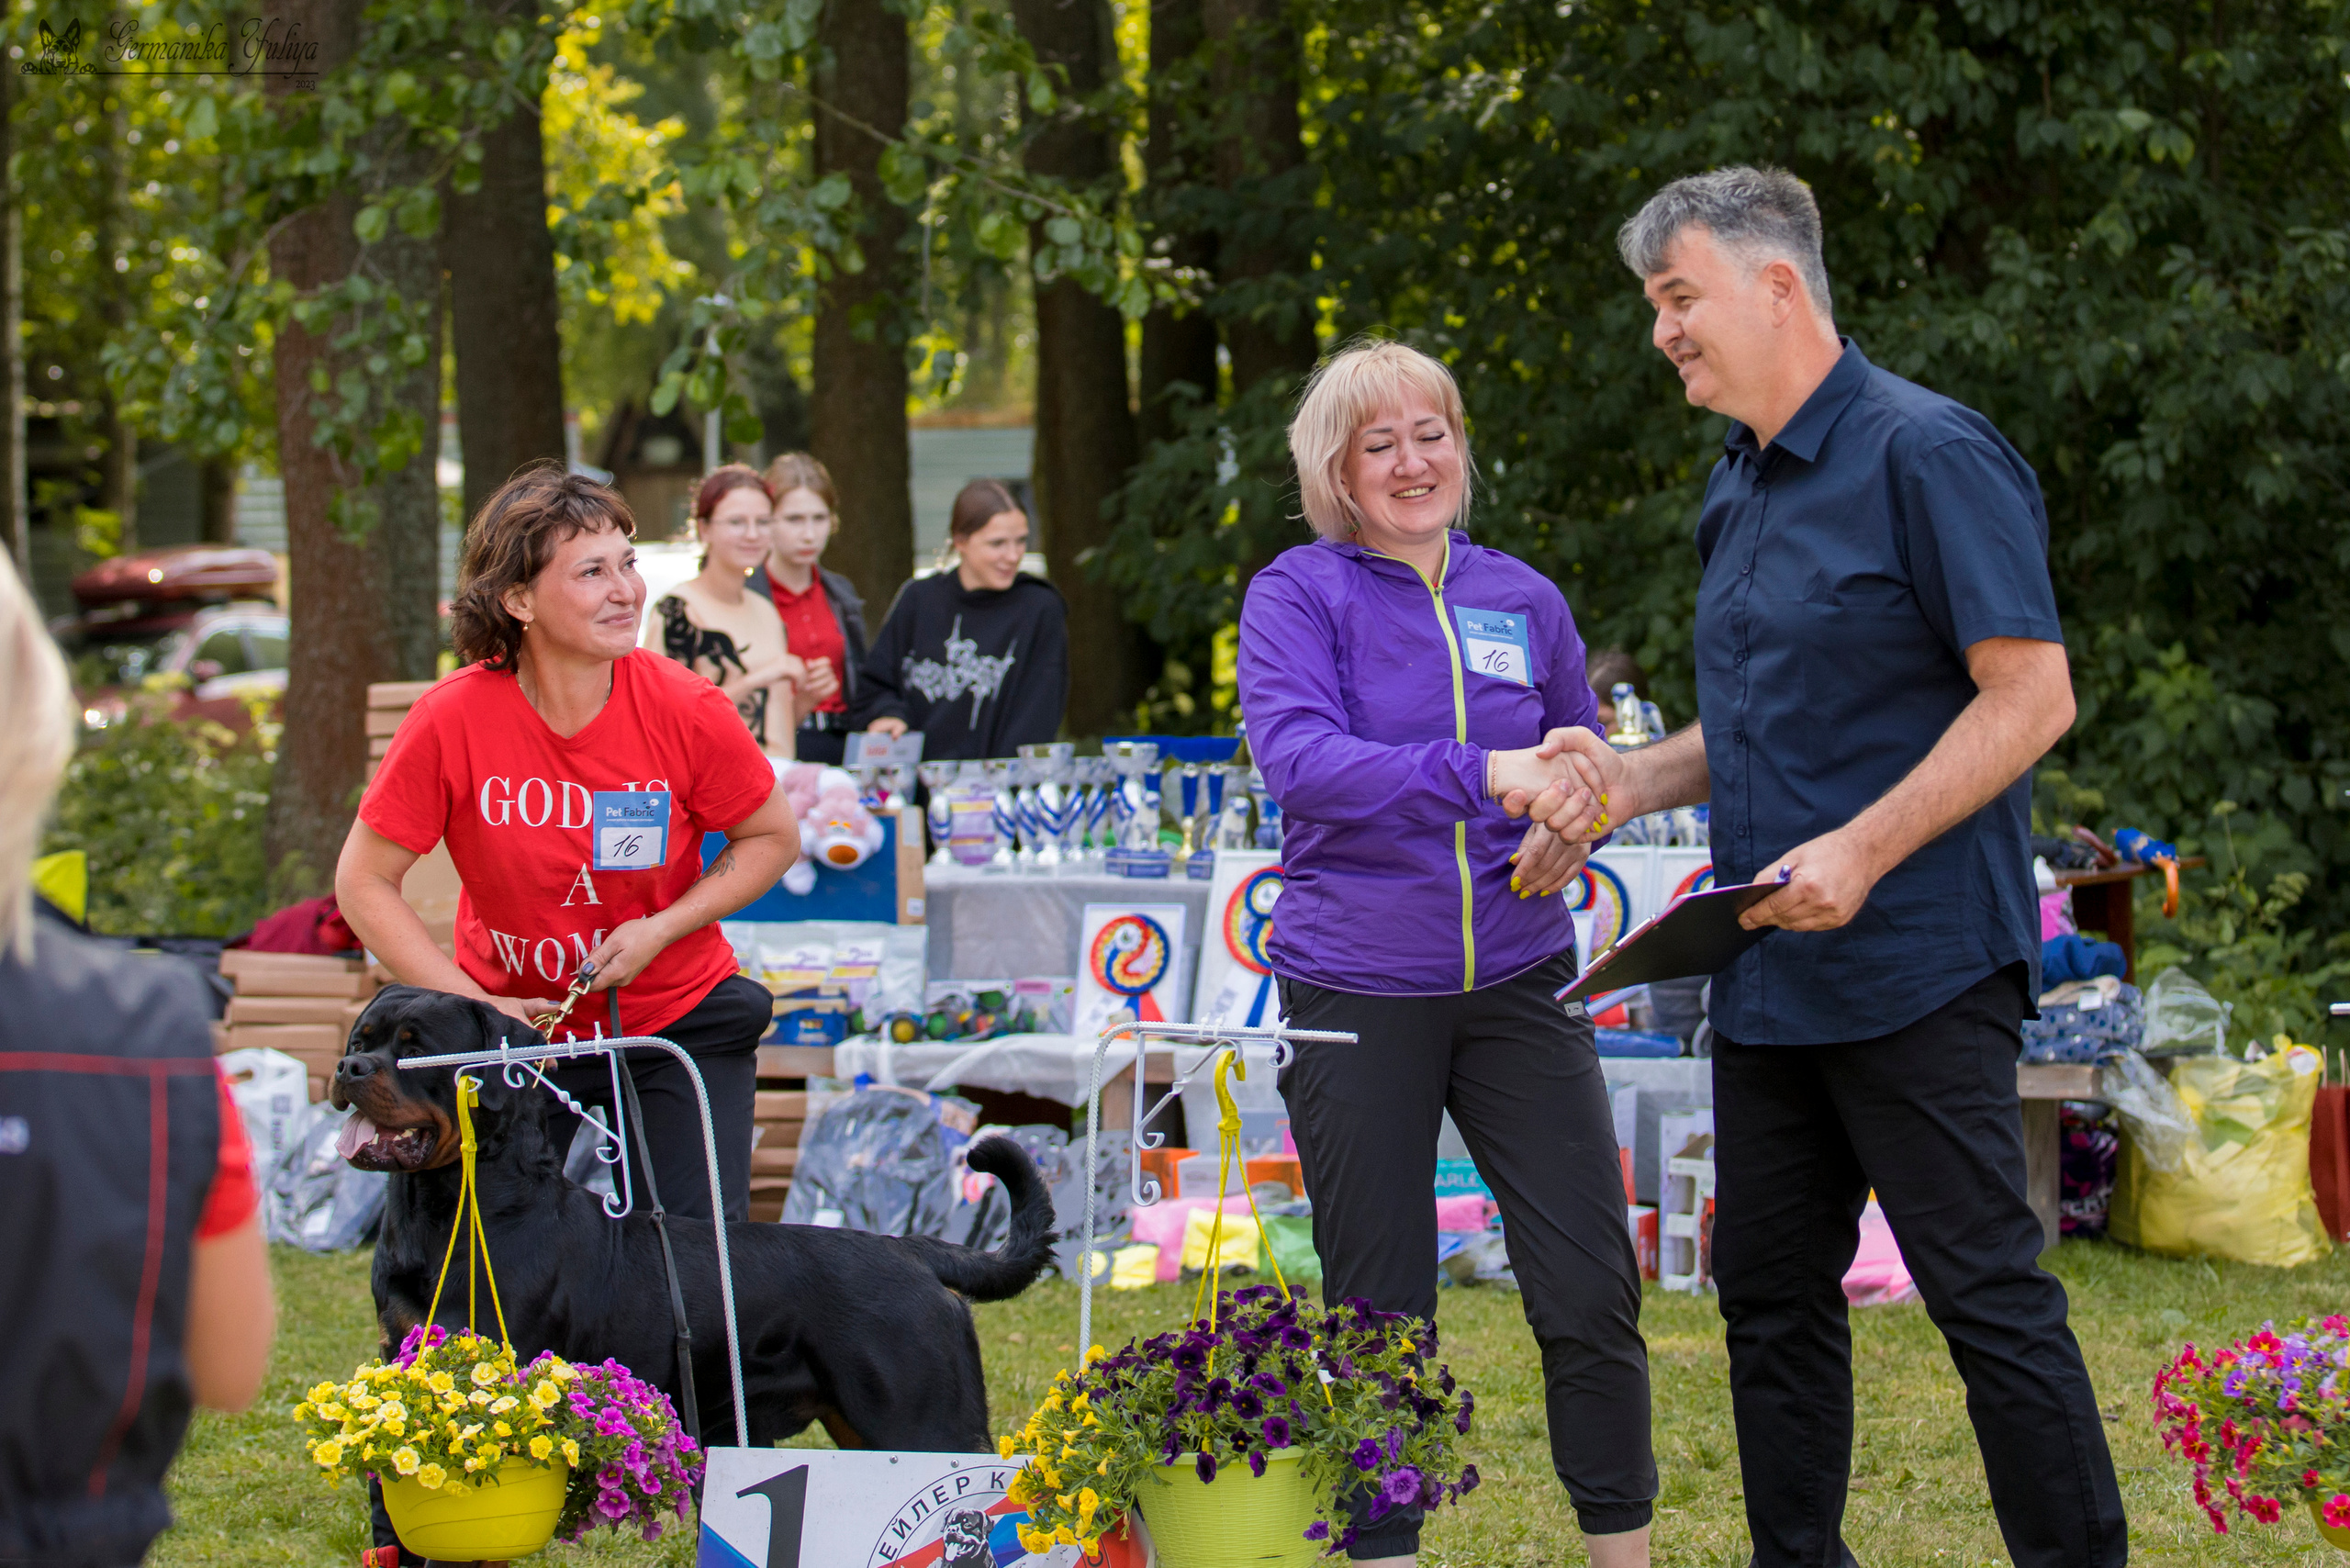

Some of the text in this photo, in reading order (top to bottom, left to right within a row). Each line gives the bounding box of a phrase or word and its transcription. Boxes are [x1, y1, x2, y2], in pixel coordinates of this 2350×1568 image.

[1467, 620, 1483, 632] Pet
[1483, 622, 1513, 635] Fabric
[1483, 649, 1510, 673] 16
[480, 776, 593, 829] GOD
[606, 807, 655, 817] Pet Fabric
[613, 834, 643, 857] 16
[560, 862, 603, 906] A
[736, 1464, 809, 1568] 1
